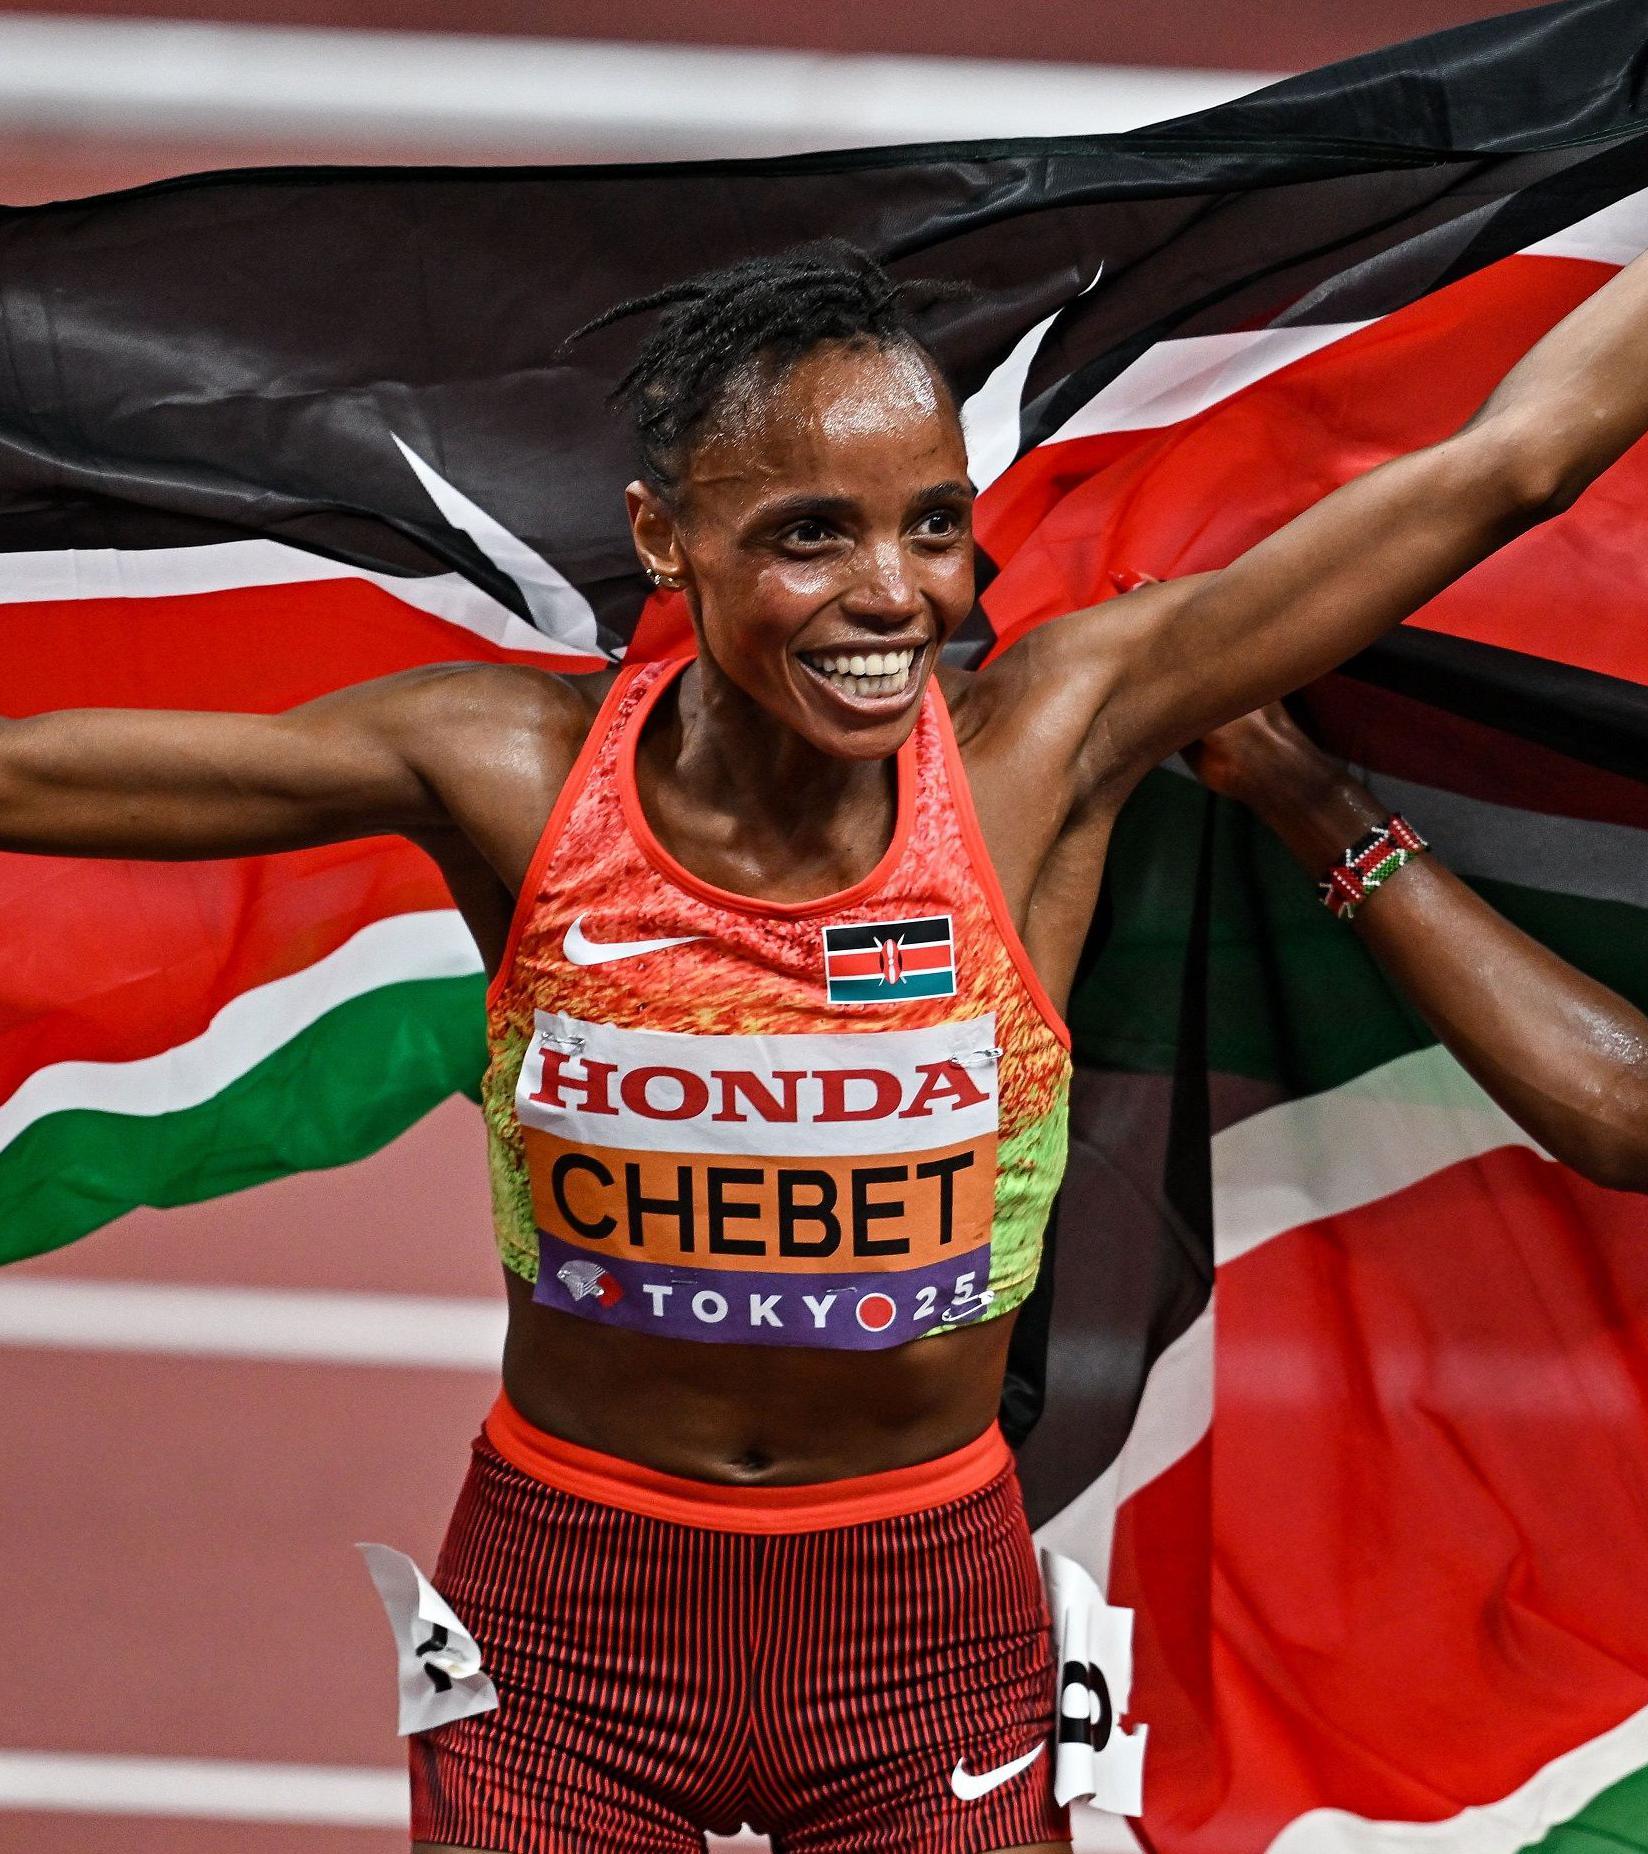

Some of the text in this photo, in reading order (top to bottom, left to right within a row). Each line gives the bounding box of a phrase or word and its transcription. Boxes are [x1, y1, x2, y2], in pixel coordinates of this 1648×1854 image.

[529, 1046, 989, 1123] HONDA
[551, 1150, 975, 1259] CHEBET
[913, 1270, 976, 1321] 25
